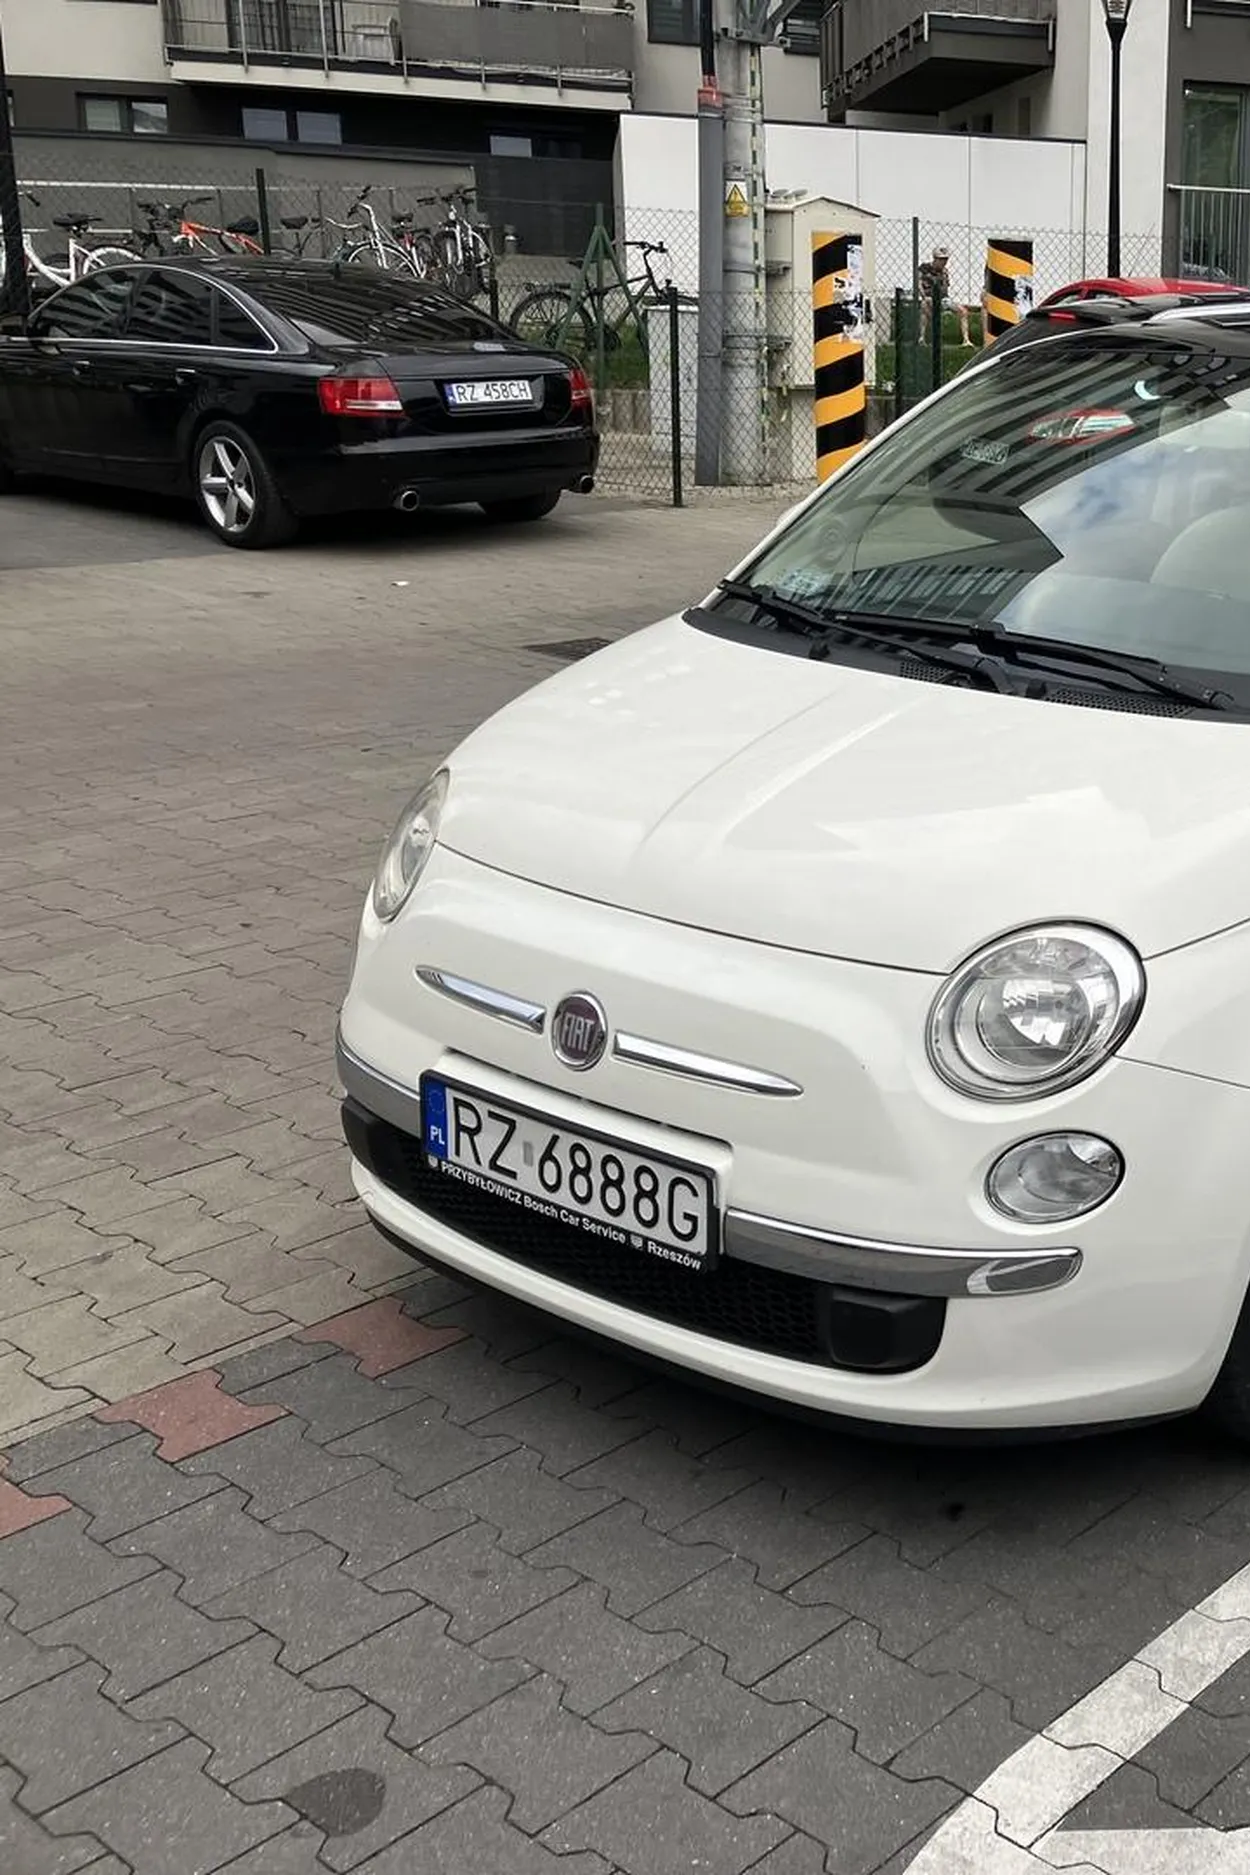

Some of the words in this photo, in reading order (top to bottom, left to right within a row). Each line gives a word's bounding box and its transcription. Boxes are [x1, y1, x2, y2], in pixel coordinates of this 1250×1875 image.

[456, 384, 478, 401] RZ
[484, 381, 529, 400] 458CH
[561, 1011, 595, 1052] FIAT
[430, 1125, 445, 1145] PL
[453, 1096, 518, 1181] RZ
[538, 1133, 699, 1243] 6888G
[523, 1196, 559, 1220] Bosch
[560, 1209, 580, 1224] Car
[581, 1217, 626, 1244] Service
[647, 1240, 701, 1270] Rzeszów
